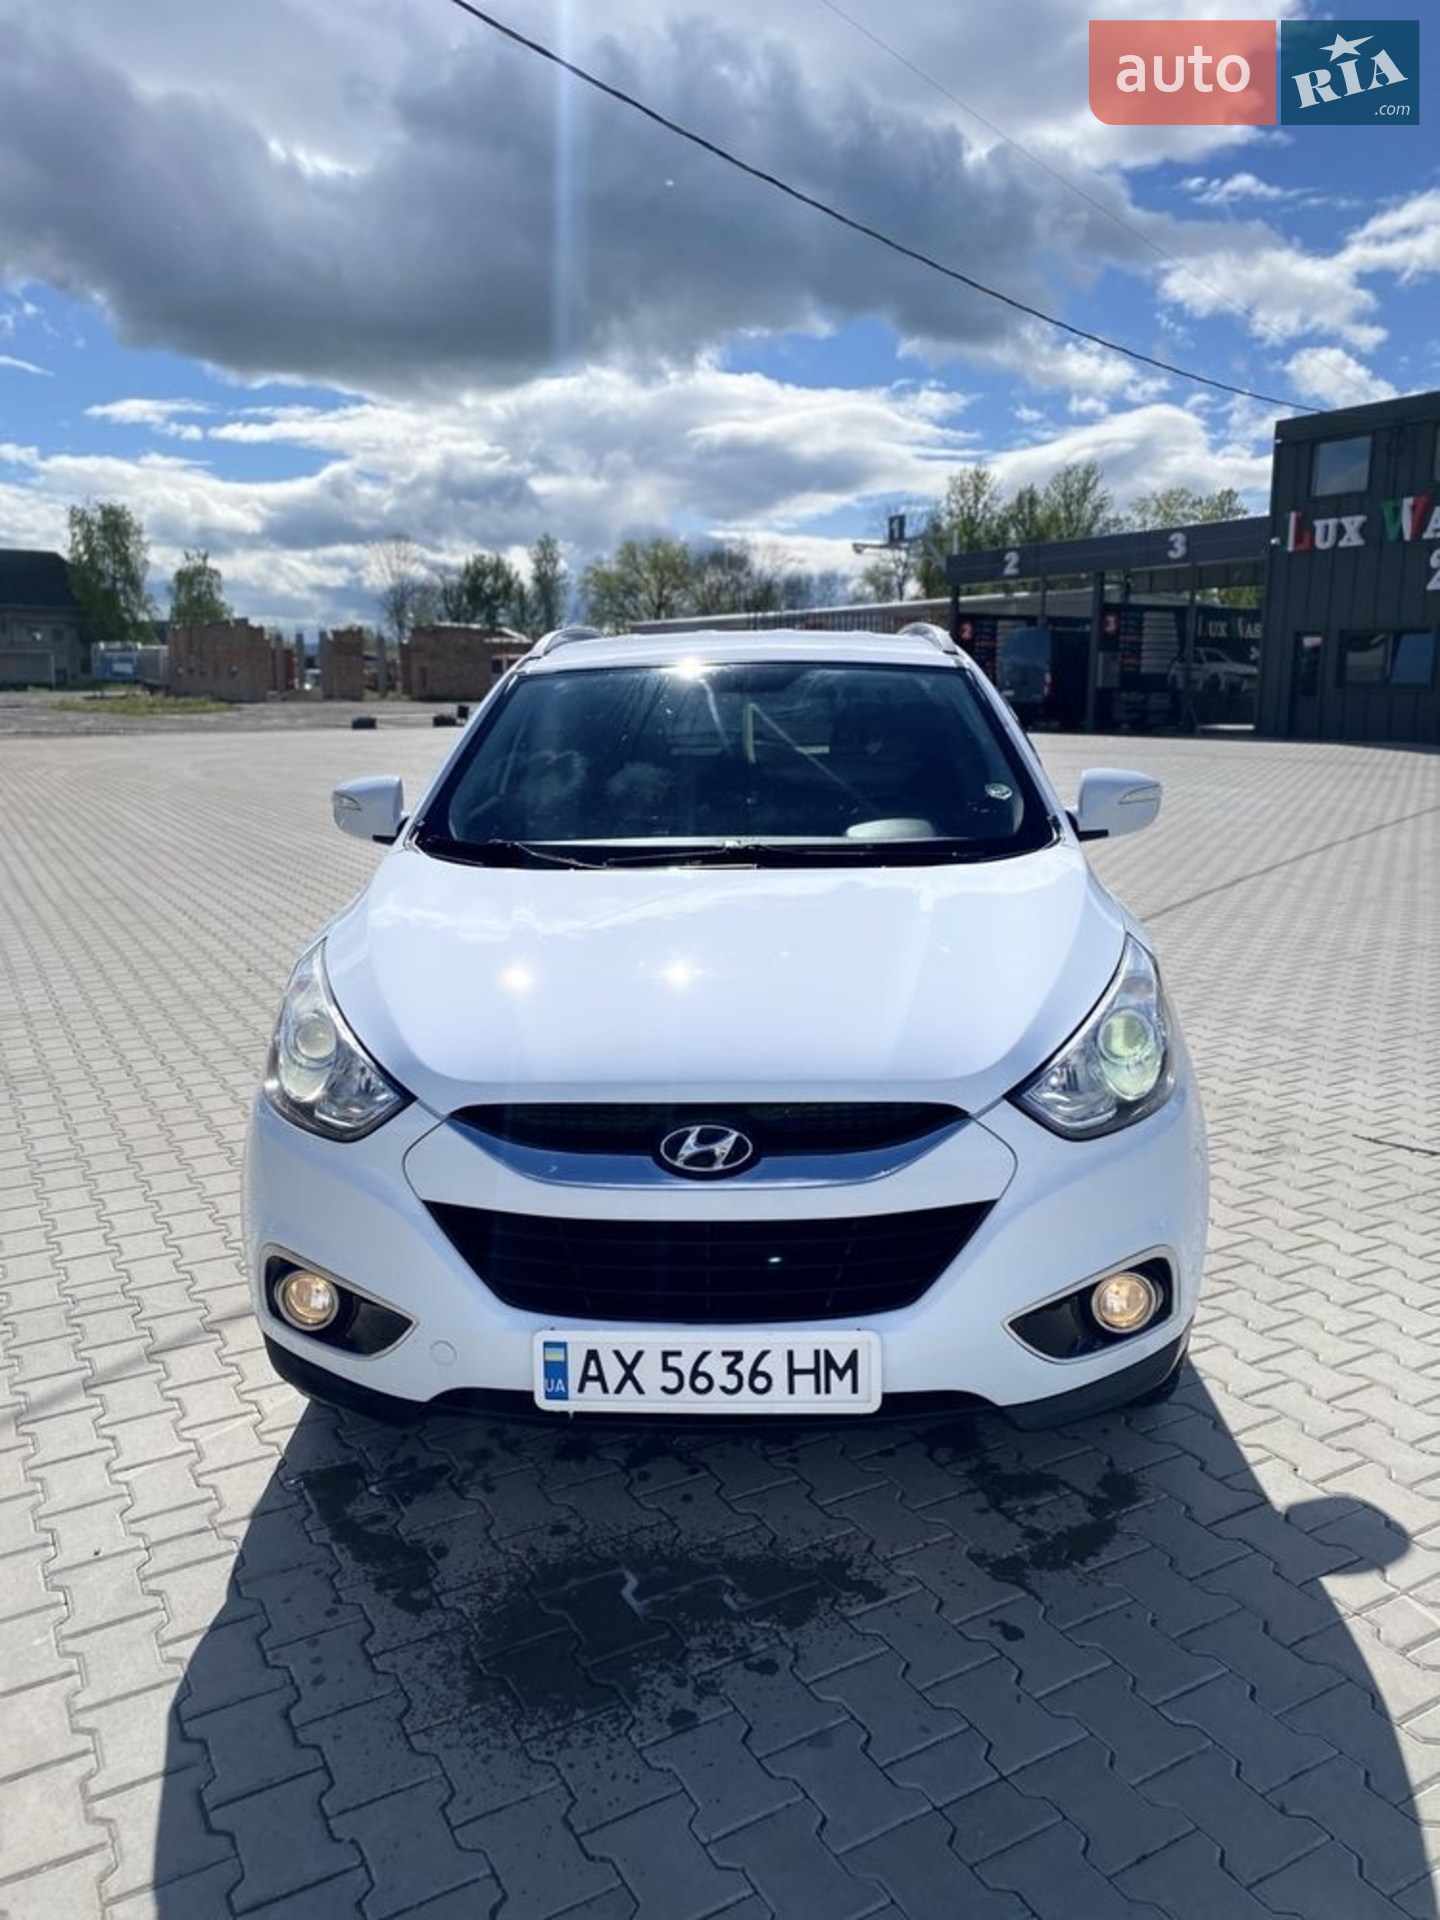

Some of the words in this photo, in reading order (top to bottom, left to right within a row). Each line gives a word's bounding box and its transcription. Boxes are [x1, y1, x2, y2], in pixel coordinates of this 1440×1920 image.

[1288, 510, 1368, 553] LUX
[1167, 532, 1188, 559] 3
[1003, 551, 1021, 576] 2
[545, 1378, 566, 1392] UA
[577, 1348, 646, 1395] AX
[660, 1349, 774, 1396] 5636
[786, 1348, 859, 1395] HM
